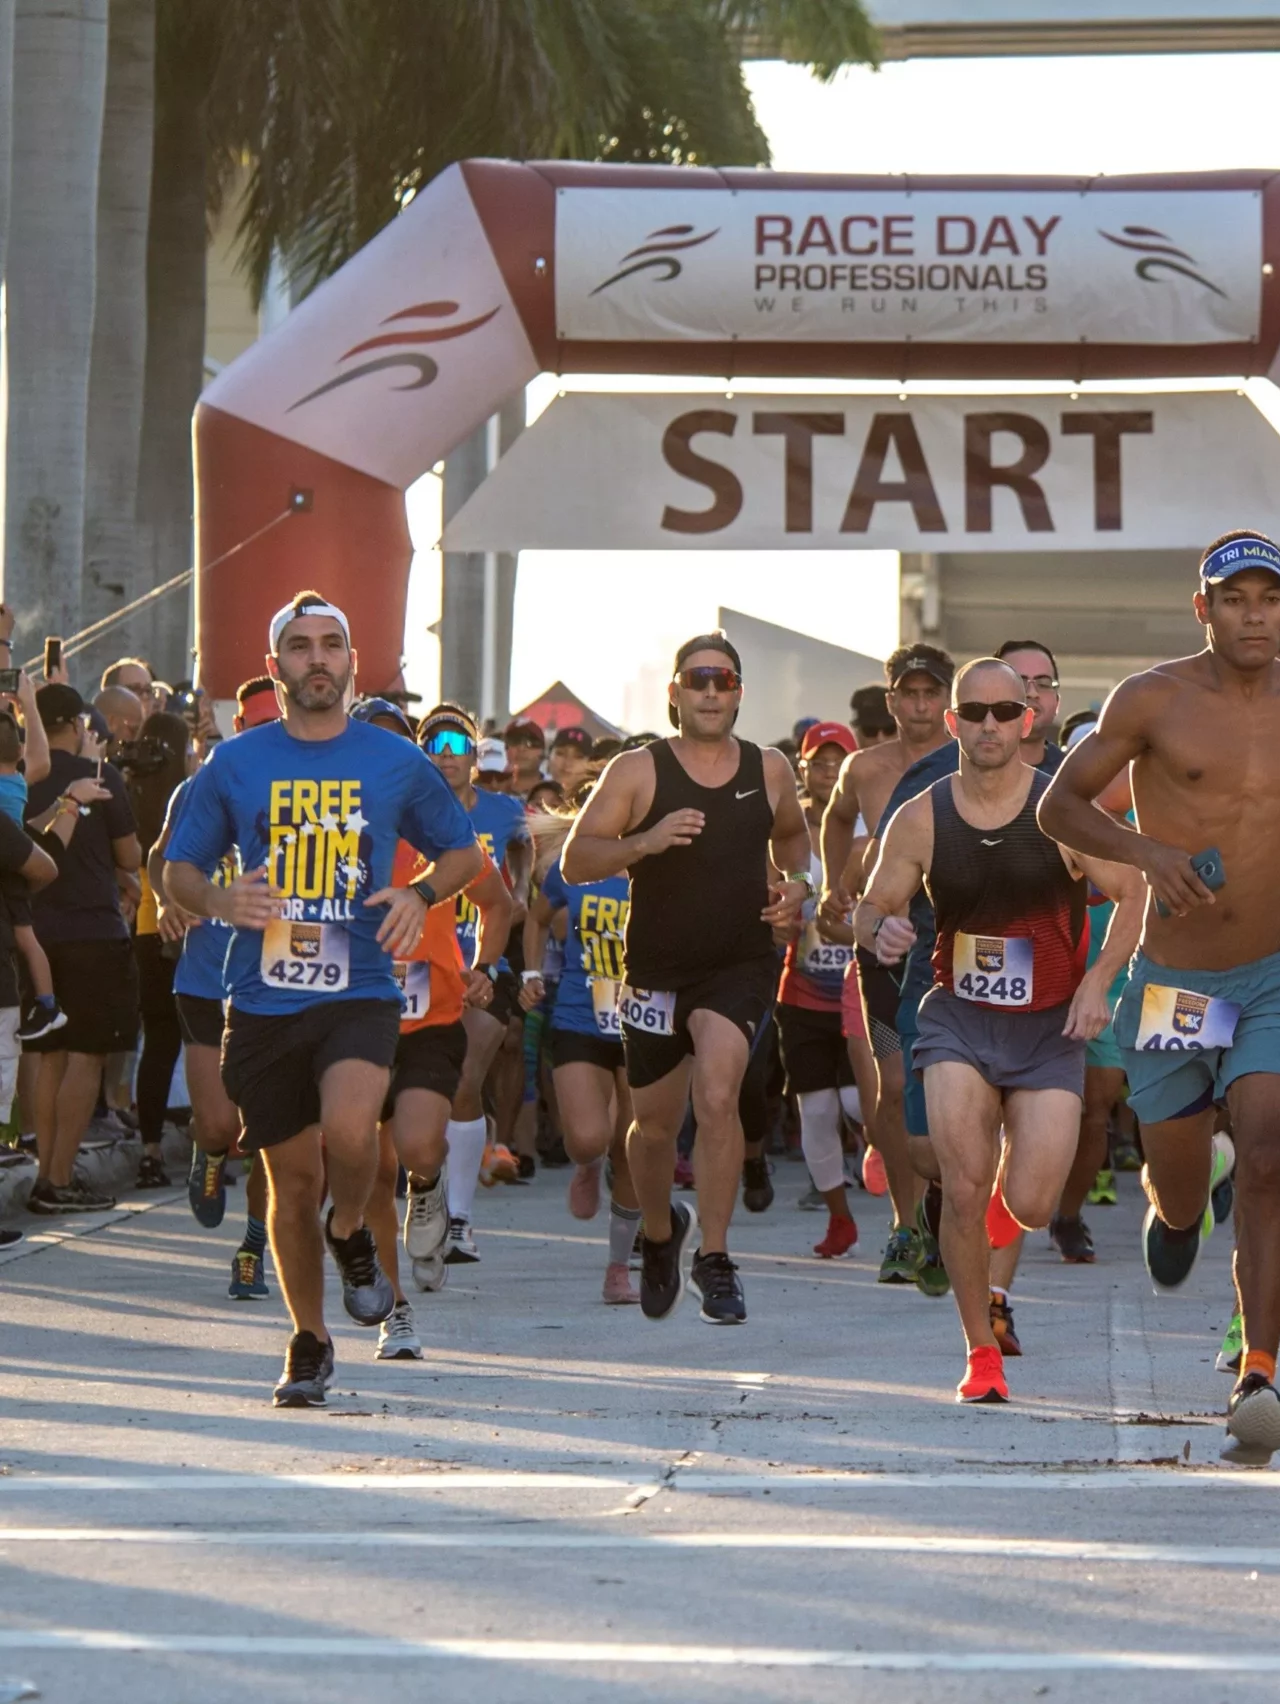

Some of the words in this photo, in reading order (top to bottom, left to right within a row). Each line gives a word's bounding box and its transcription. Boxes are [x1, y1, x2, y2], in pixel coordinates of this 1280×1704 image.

[755, 215, 916, 256] RACE
[935, 215, 1062, 257] DAY
[755, 264, 1048, 291] PROFESSIONALS
[755, 297, 803, 313] WE
[842, 297, 918, 314] RUN
[955, 297, 1049, 314] THIS
[660, 409, 1155, 535] START
[1220, 547, 1240, 563] TRI
[1243, 546, 1280, 567] MIAMI
[270, 780, 361, 824] FREE
[267, 825, 360, 899] DOM
[279, 898, 304, 920] OR
[320, 898, 355, 920] ALL
[268, 959, 341, 986] 4279
[959, 972, 1027, 1000] 4248
[620, 998, 666, 1030] 4061
